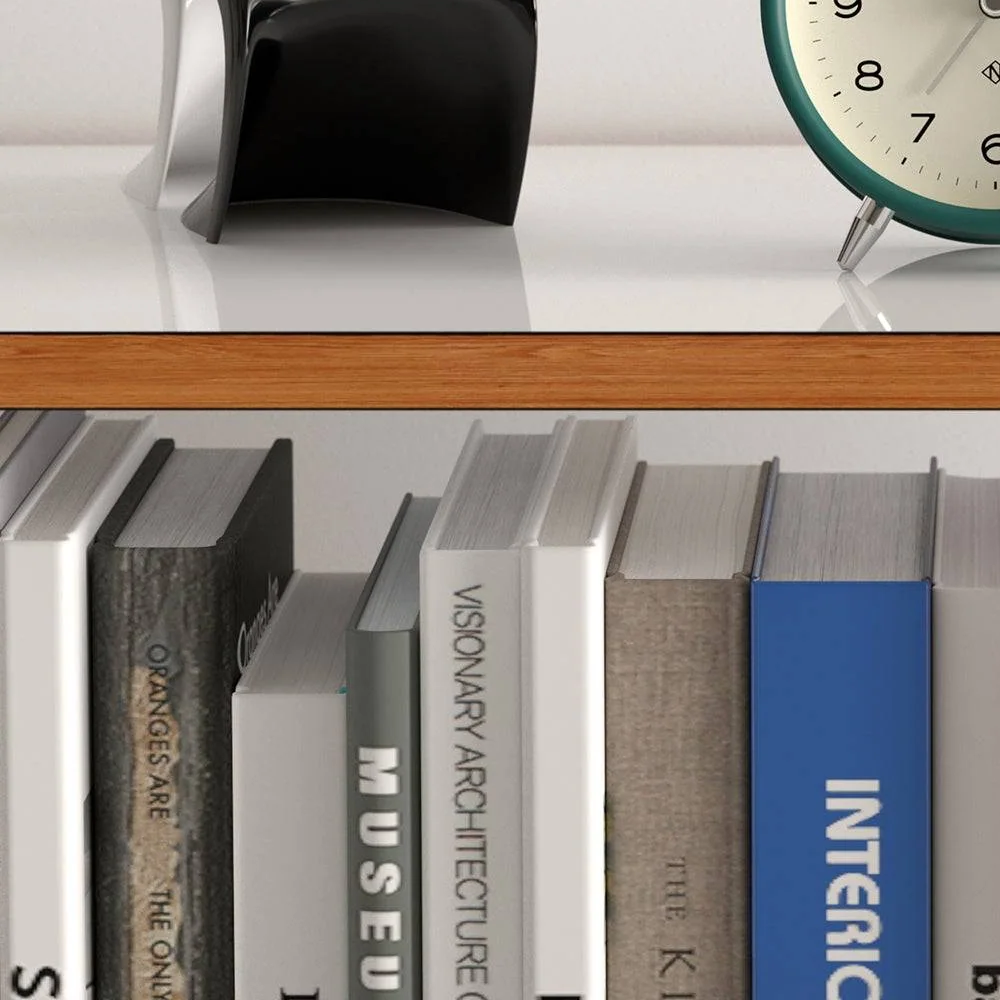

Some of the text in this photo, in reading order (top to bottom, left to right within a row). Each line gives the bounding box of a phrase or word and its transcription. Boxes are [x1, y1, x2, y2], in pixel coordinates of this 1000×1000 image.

[854, 60, 884, 92] 8
[910, 113, 936, 144] 7
[453, 584, 486, 740] VISIONARY
[148, 643, 169, 768] ORANGES
[149, 773, 171, 819] ARE
[358, 746, 402, 991] MUSEU
[454, 744, 489, 986] ARCHITECTURE
[665, 856, 687, 922] THE
[150, 889, 173, 931] THE
